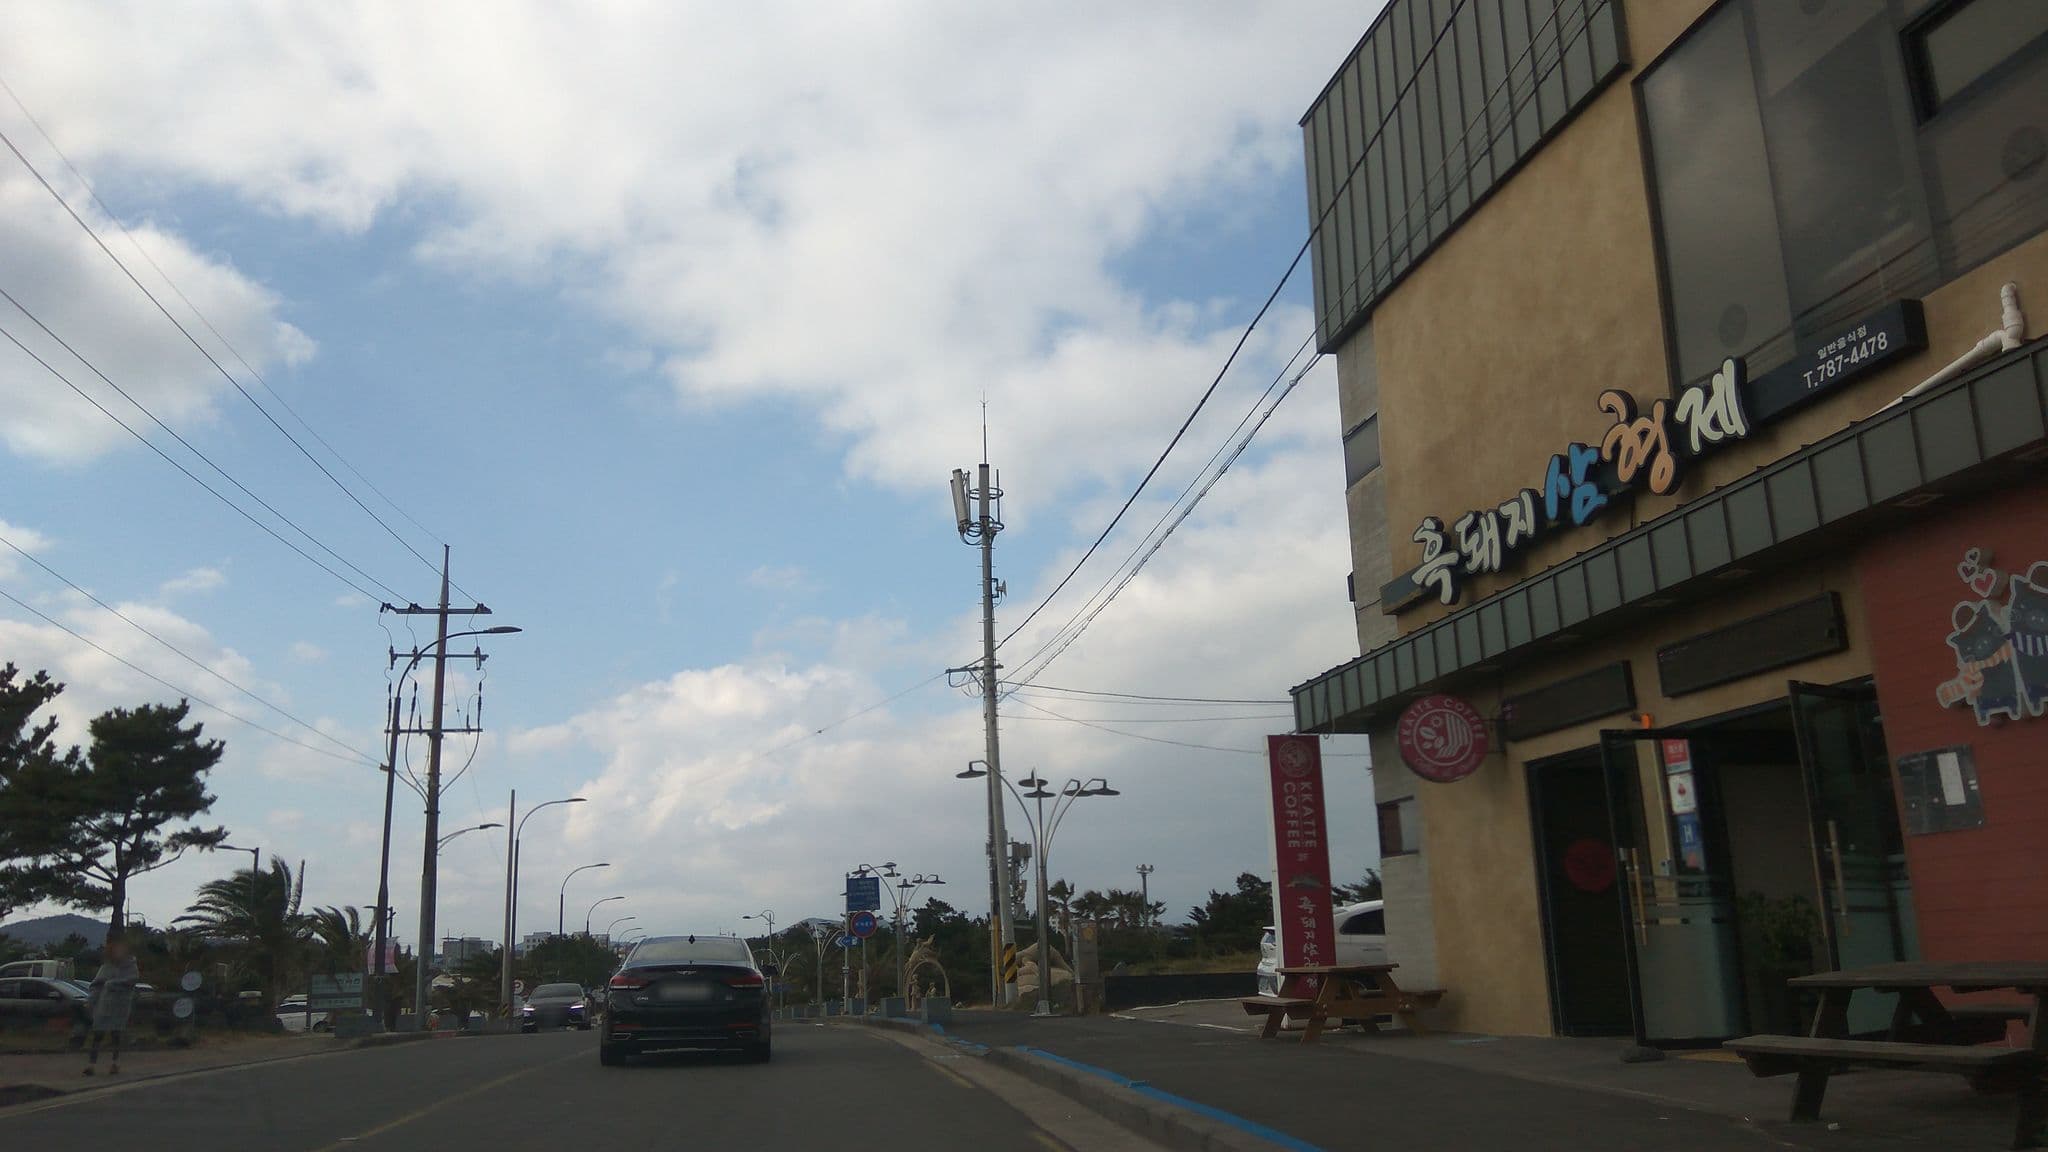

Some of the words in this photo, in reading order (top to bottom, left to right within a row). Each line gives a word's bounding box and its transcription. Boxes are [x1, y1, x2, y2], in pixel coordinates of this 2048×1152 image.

[1802, 331, 1889, 389] T.787-4478
[1816, 324, 1867, 360] 일반음식점
[1283, 781, 1301, 848] COFFEE
[1299, 781, 1317, 849] KKATTE
